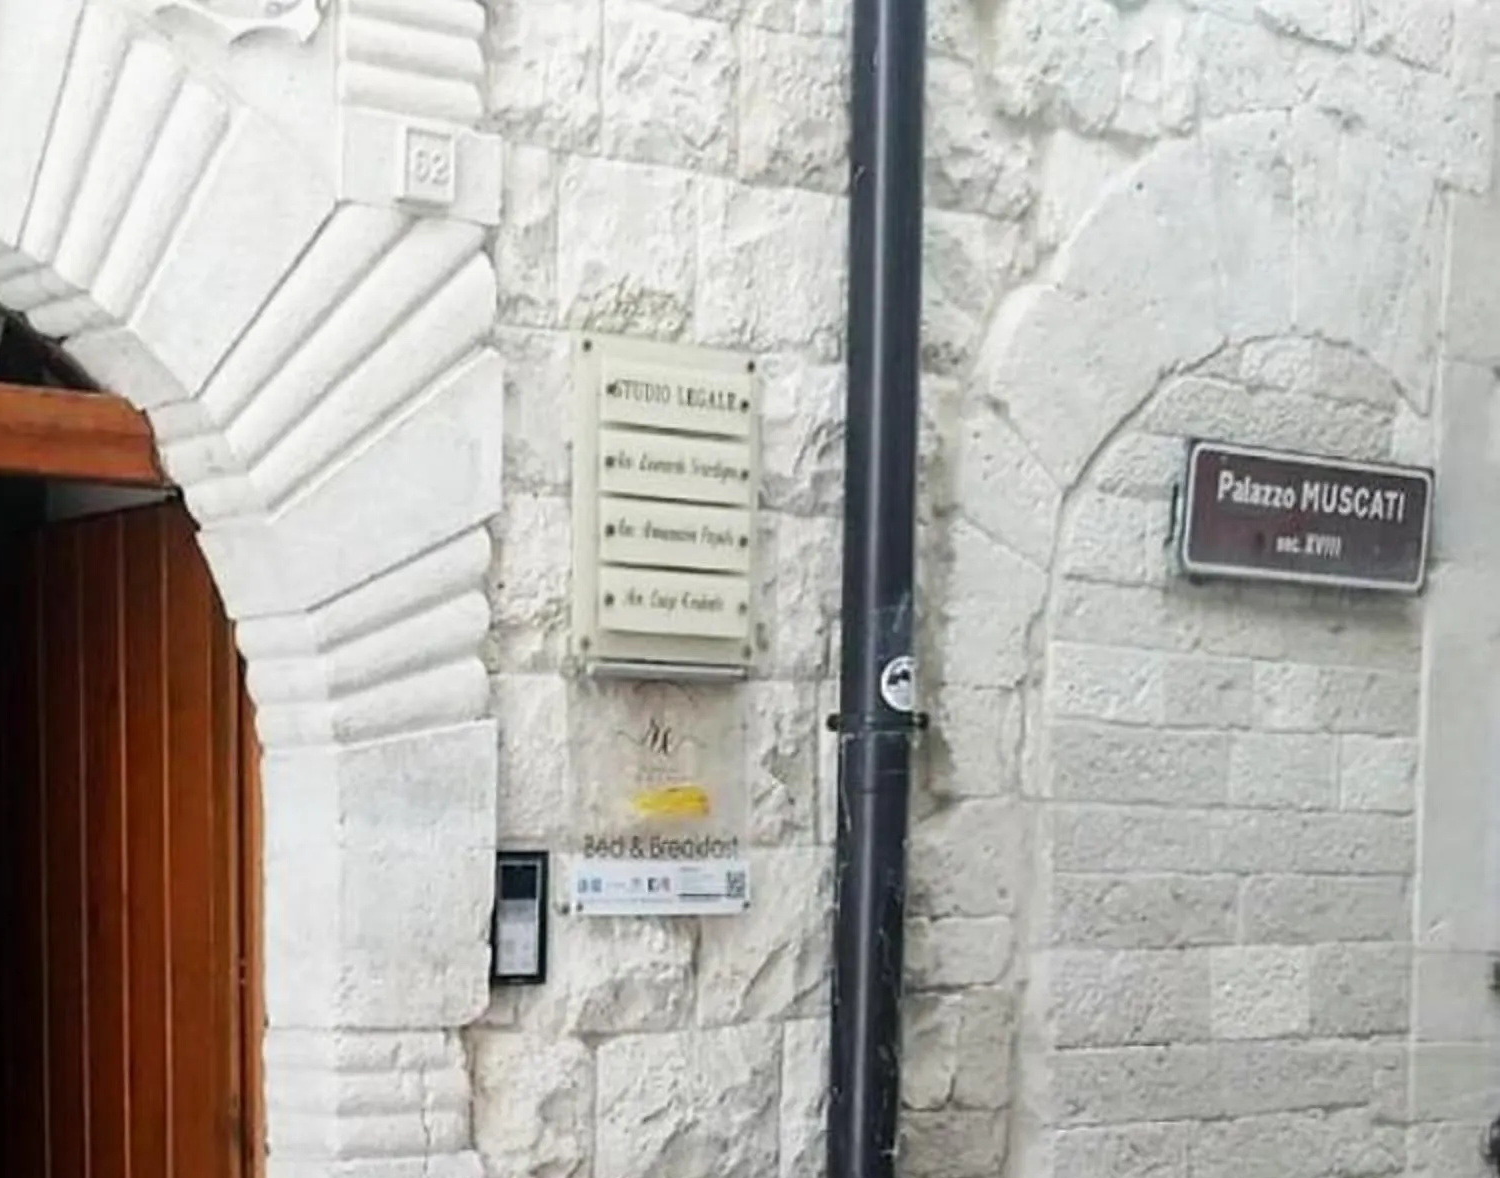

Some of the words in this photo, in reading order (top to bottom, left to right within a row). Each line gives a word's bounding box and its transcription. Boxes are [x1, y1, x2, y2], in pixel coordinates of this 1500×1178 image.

[612, 380, 671, 404] STUDIO
[676, 384, 738, 412] LEGALE
[1217, 470, 1296, 509] Palazzo
[1300, 480, 1406, 523] MUSCATI
[1304, 532, 1342, 559] XVIII
[584, 833, 624, 859] Bed
[630, 835, 644, 859] &
